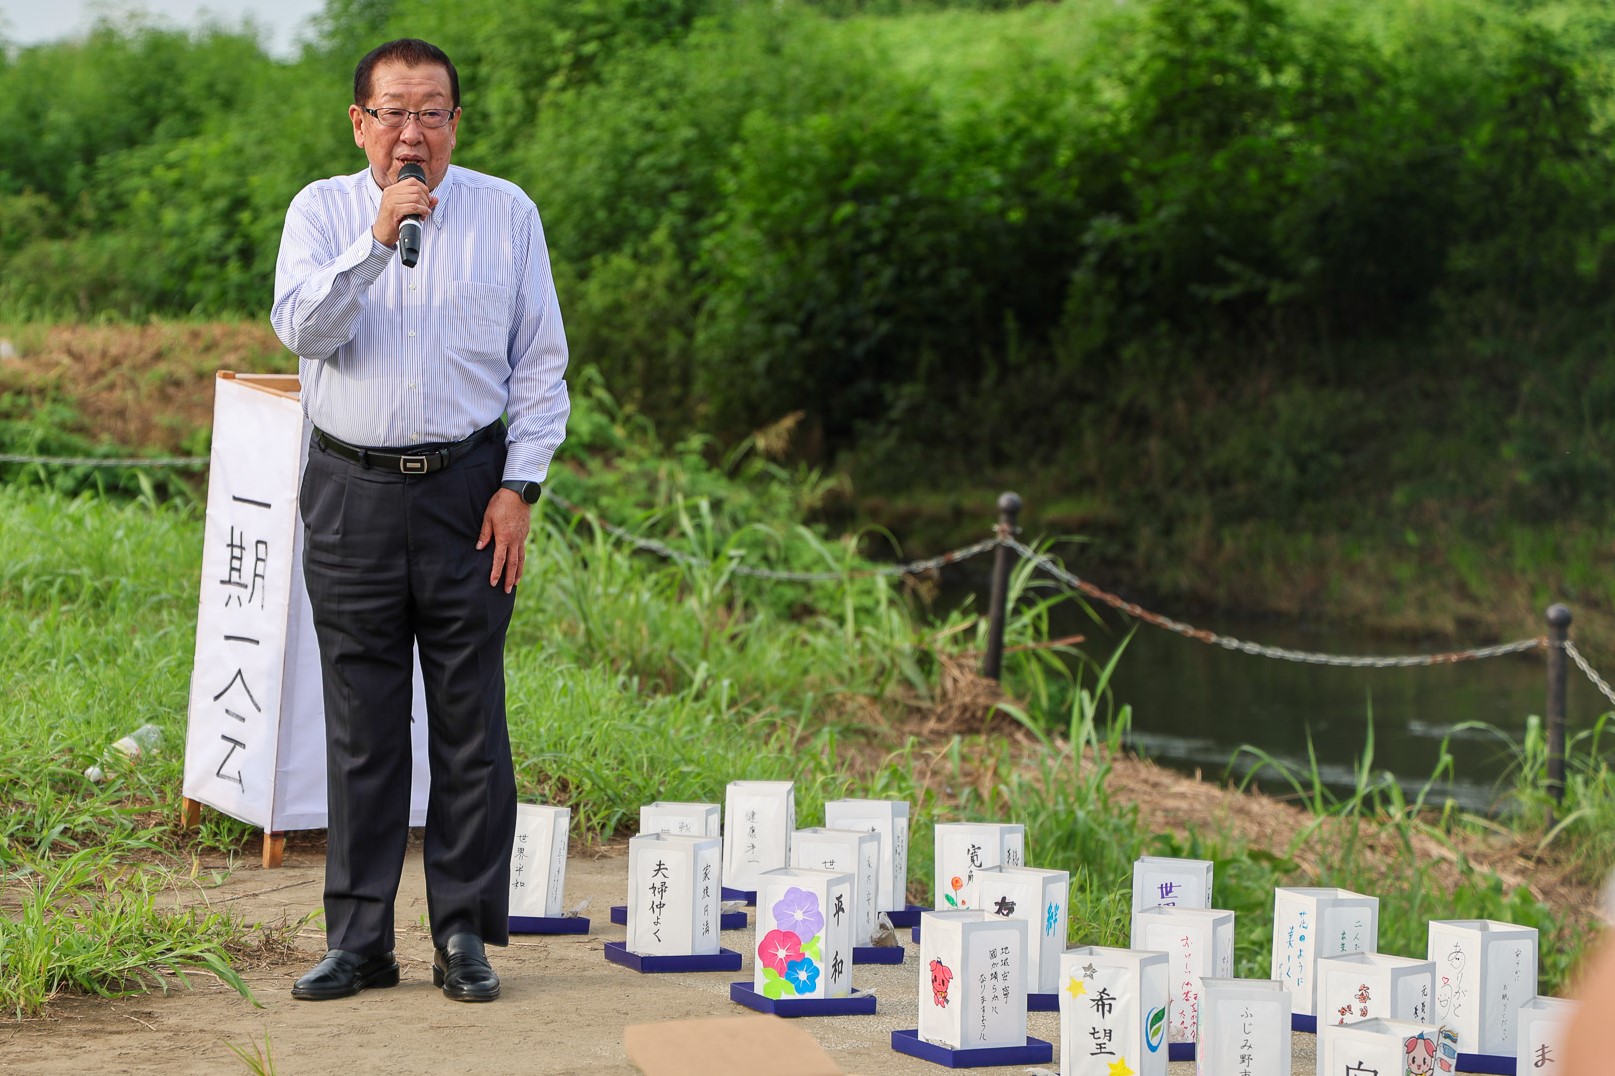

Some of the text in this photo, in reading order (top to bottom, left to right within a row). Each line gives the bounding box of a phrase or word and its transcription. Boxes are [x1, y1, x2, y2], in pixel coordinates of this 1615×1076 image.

[213, 494, 272, 794] 一期一会
[511, 833, 529, 890] 世界平和
[1157, 881, 1182, 906] 世
[648, 859, 669, 943] 夫婦仲よく
[831, 893, 845, 985] 平和
[1090, 987, 1117, 1056] 希望
[1533, 1043, 1555, 1069] ま
